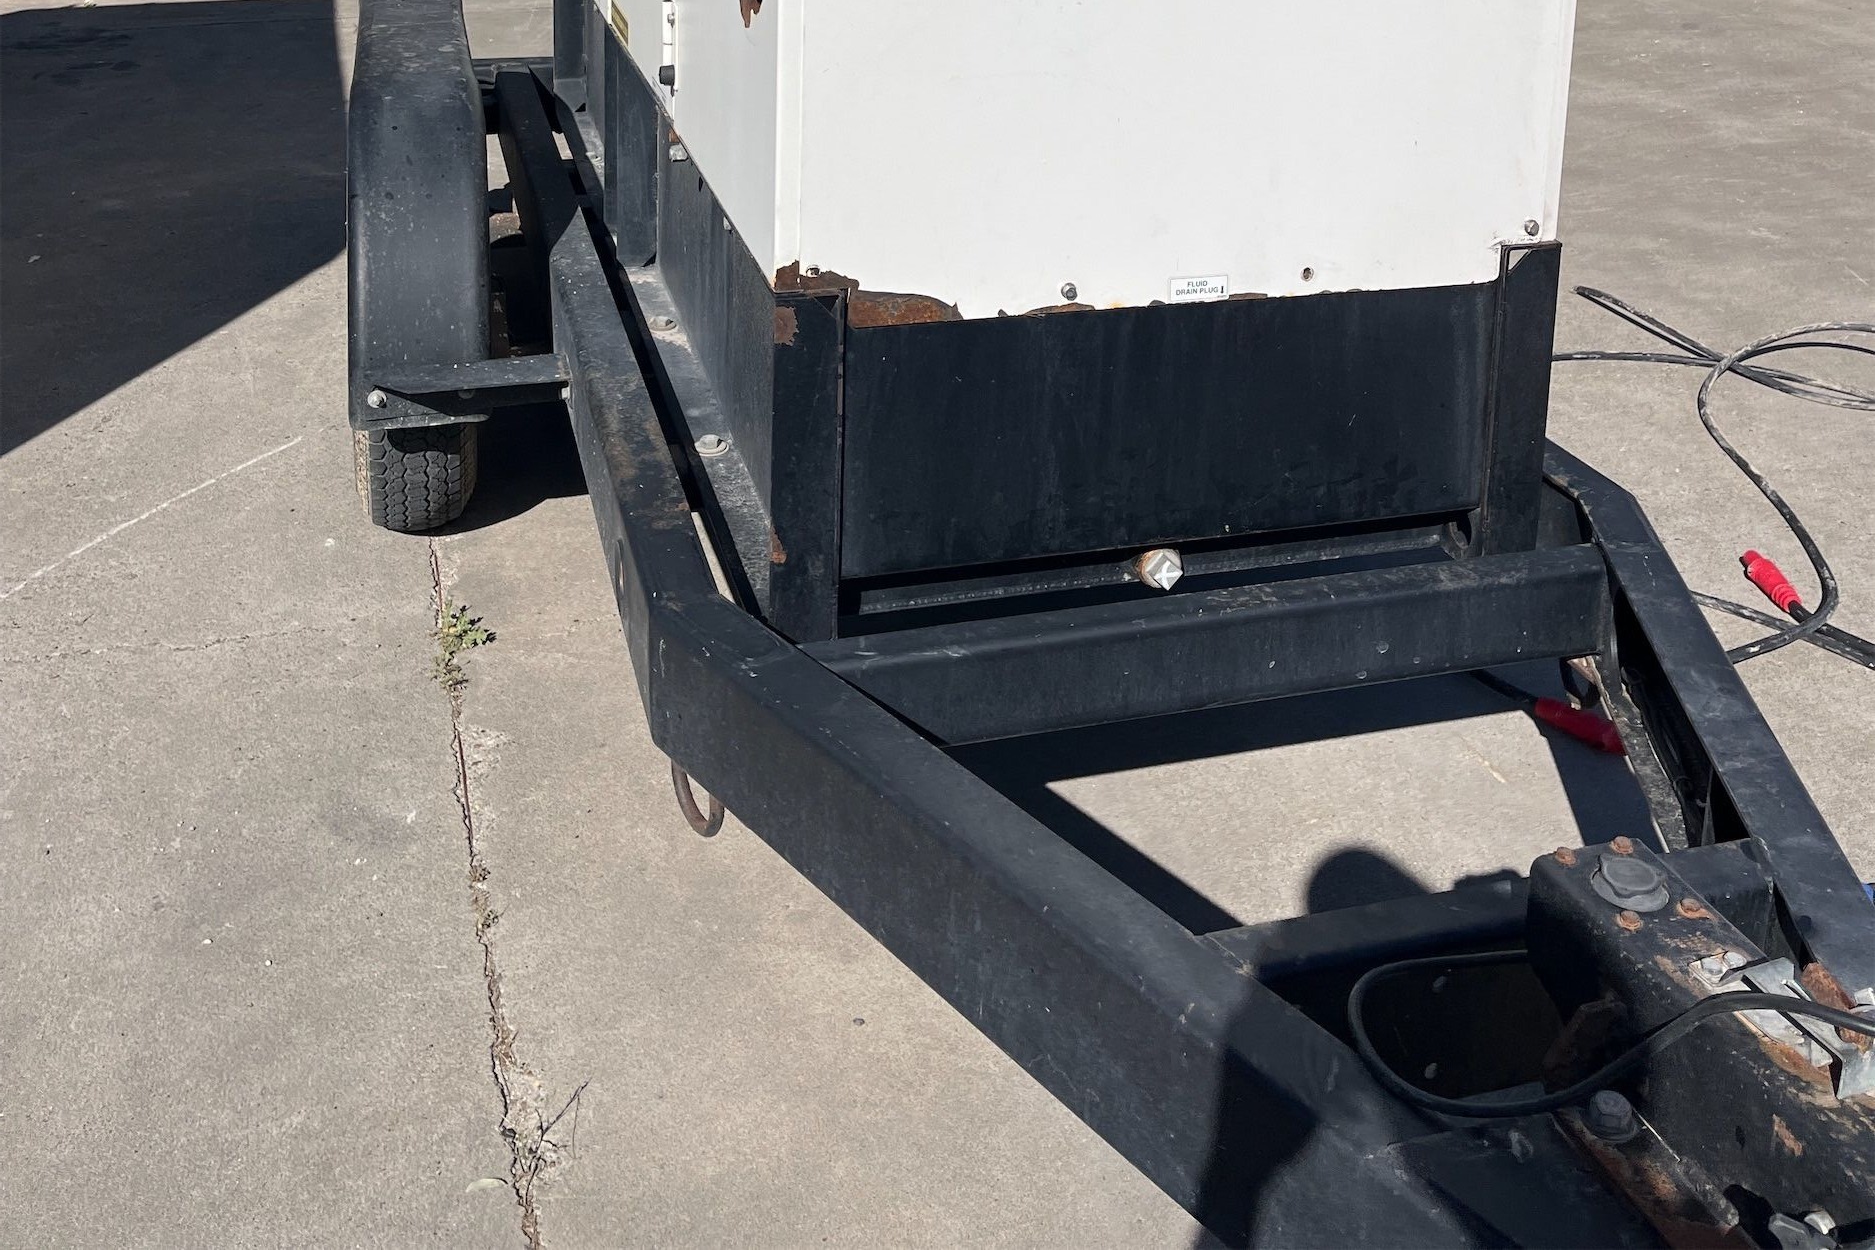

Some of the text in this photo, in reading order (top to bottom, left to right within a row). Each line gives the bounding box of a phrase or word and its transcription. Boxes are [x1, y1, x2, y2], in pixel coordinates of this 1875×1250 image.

[1187, 280, 1208, 288] FLUID
[1175, 286, 1219, 296] DRAIN PLUG
